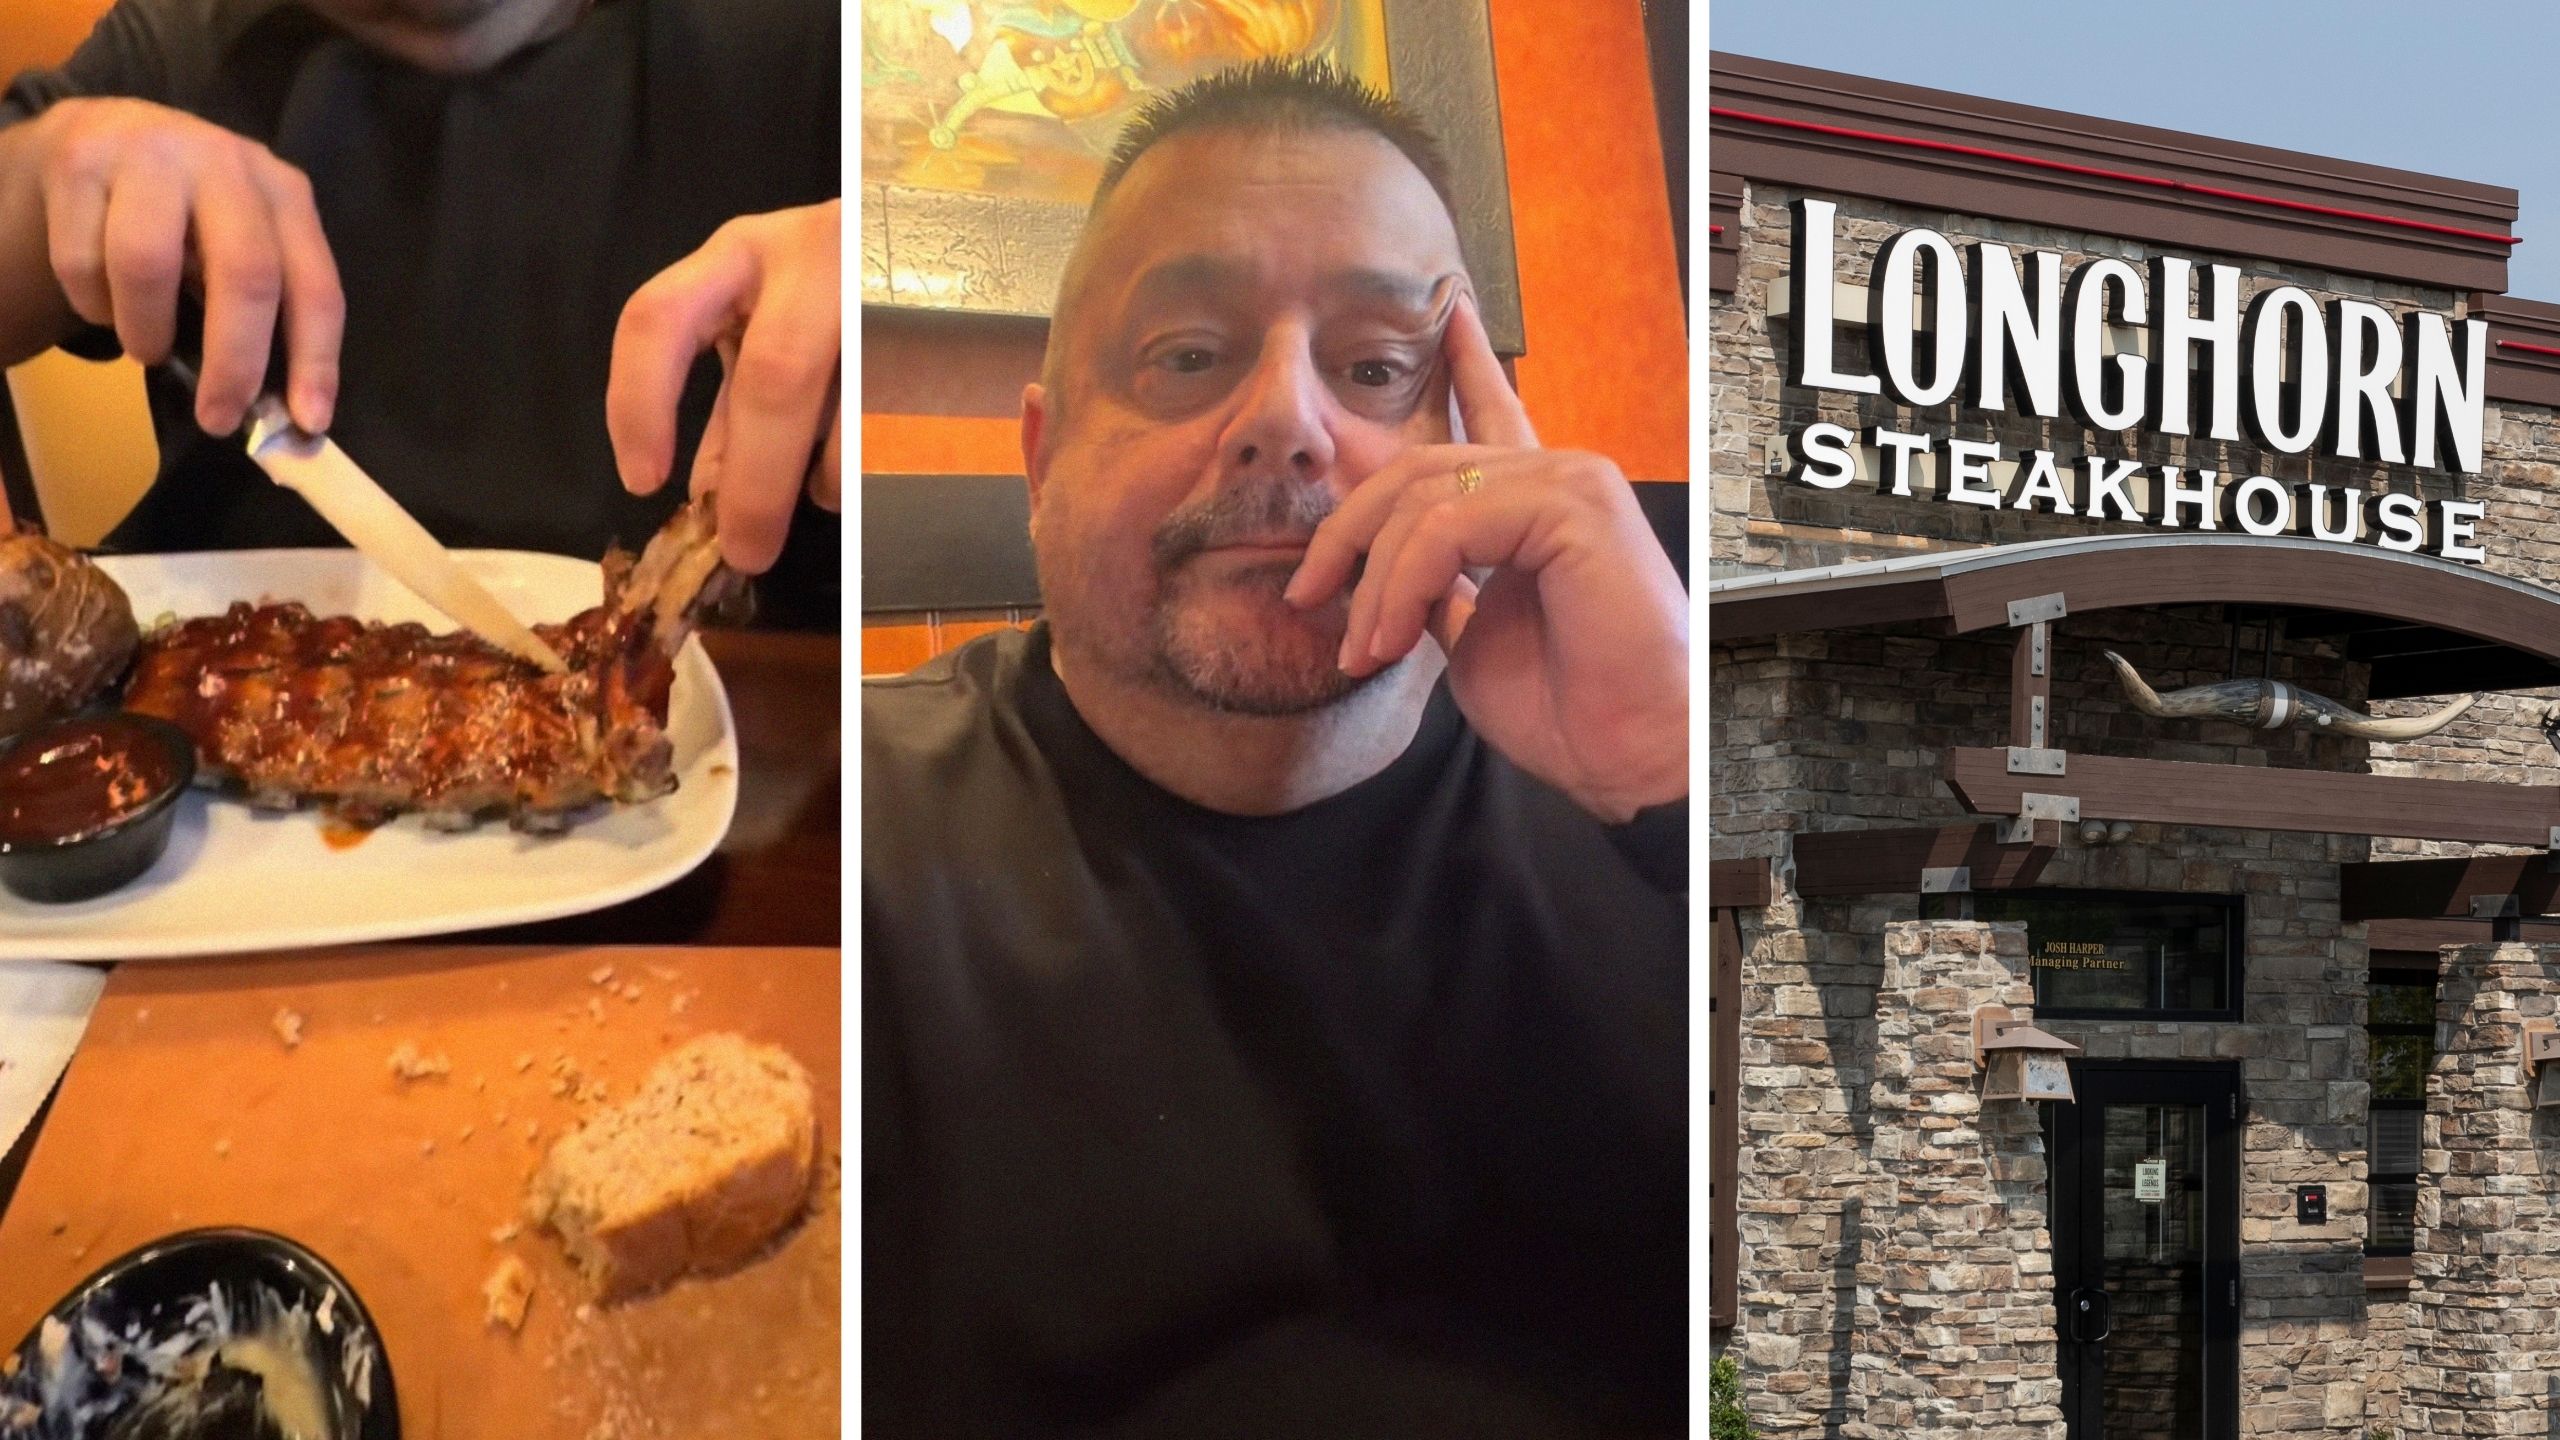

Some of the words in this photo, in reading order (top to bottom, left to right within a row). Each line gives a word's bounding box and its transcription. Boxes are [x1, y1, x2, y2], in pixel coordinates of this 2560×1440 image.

[1800, 198, 2488, 475] LONGHORN
[1800, 422, 2487, 565] STEAKHOUSE
[2044, 941, 2067, 954] JOSH
[2069, 942, 2105, 955] HARPER
[2082, 956, 2125, 969] Partner
